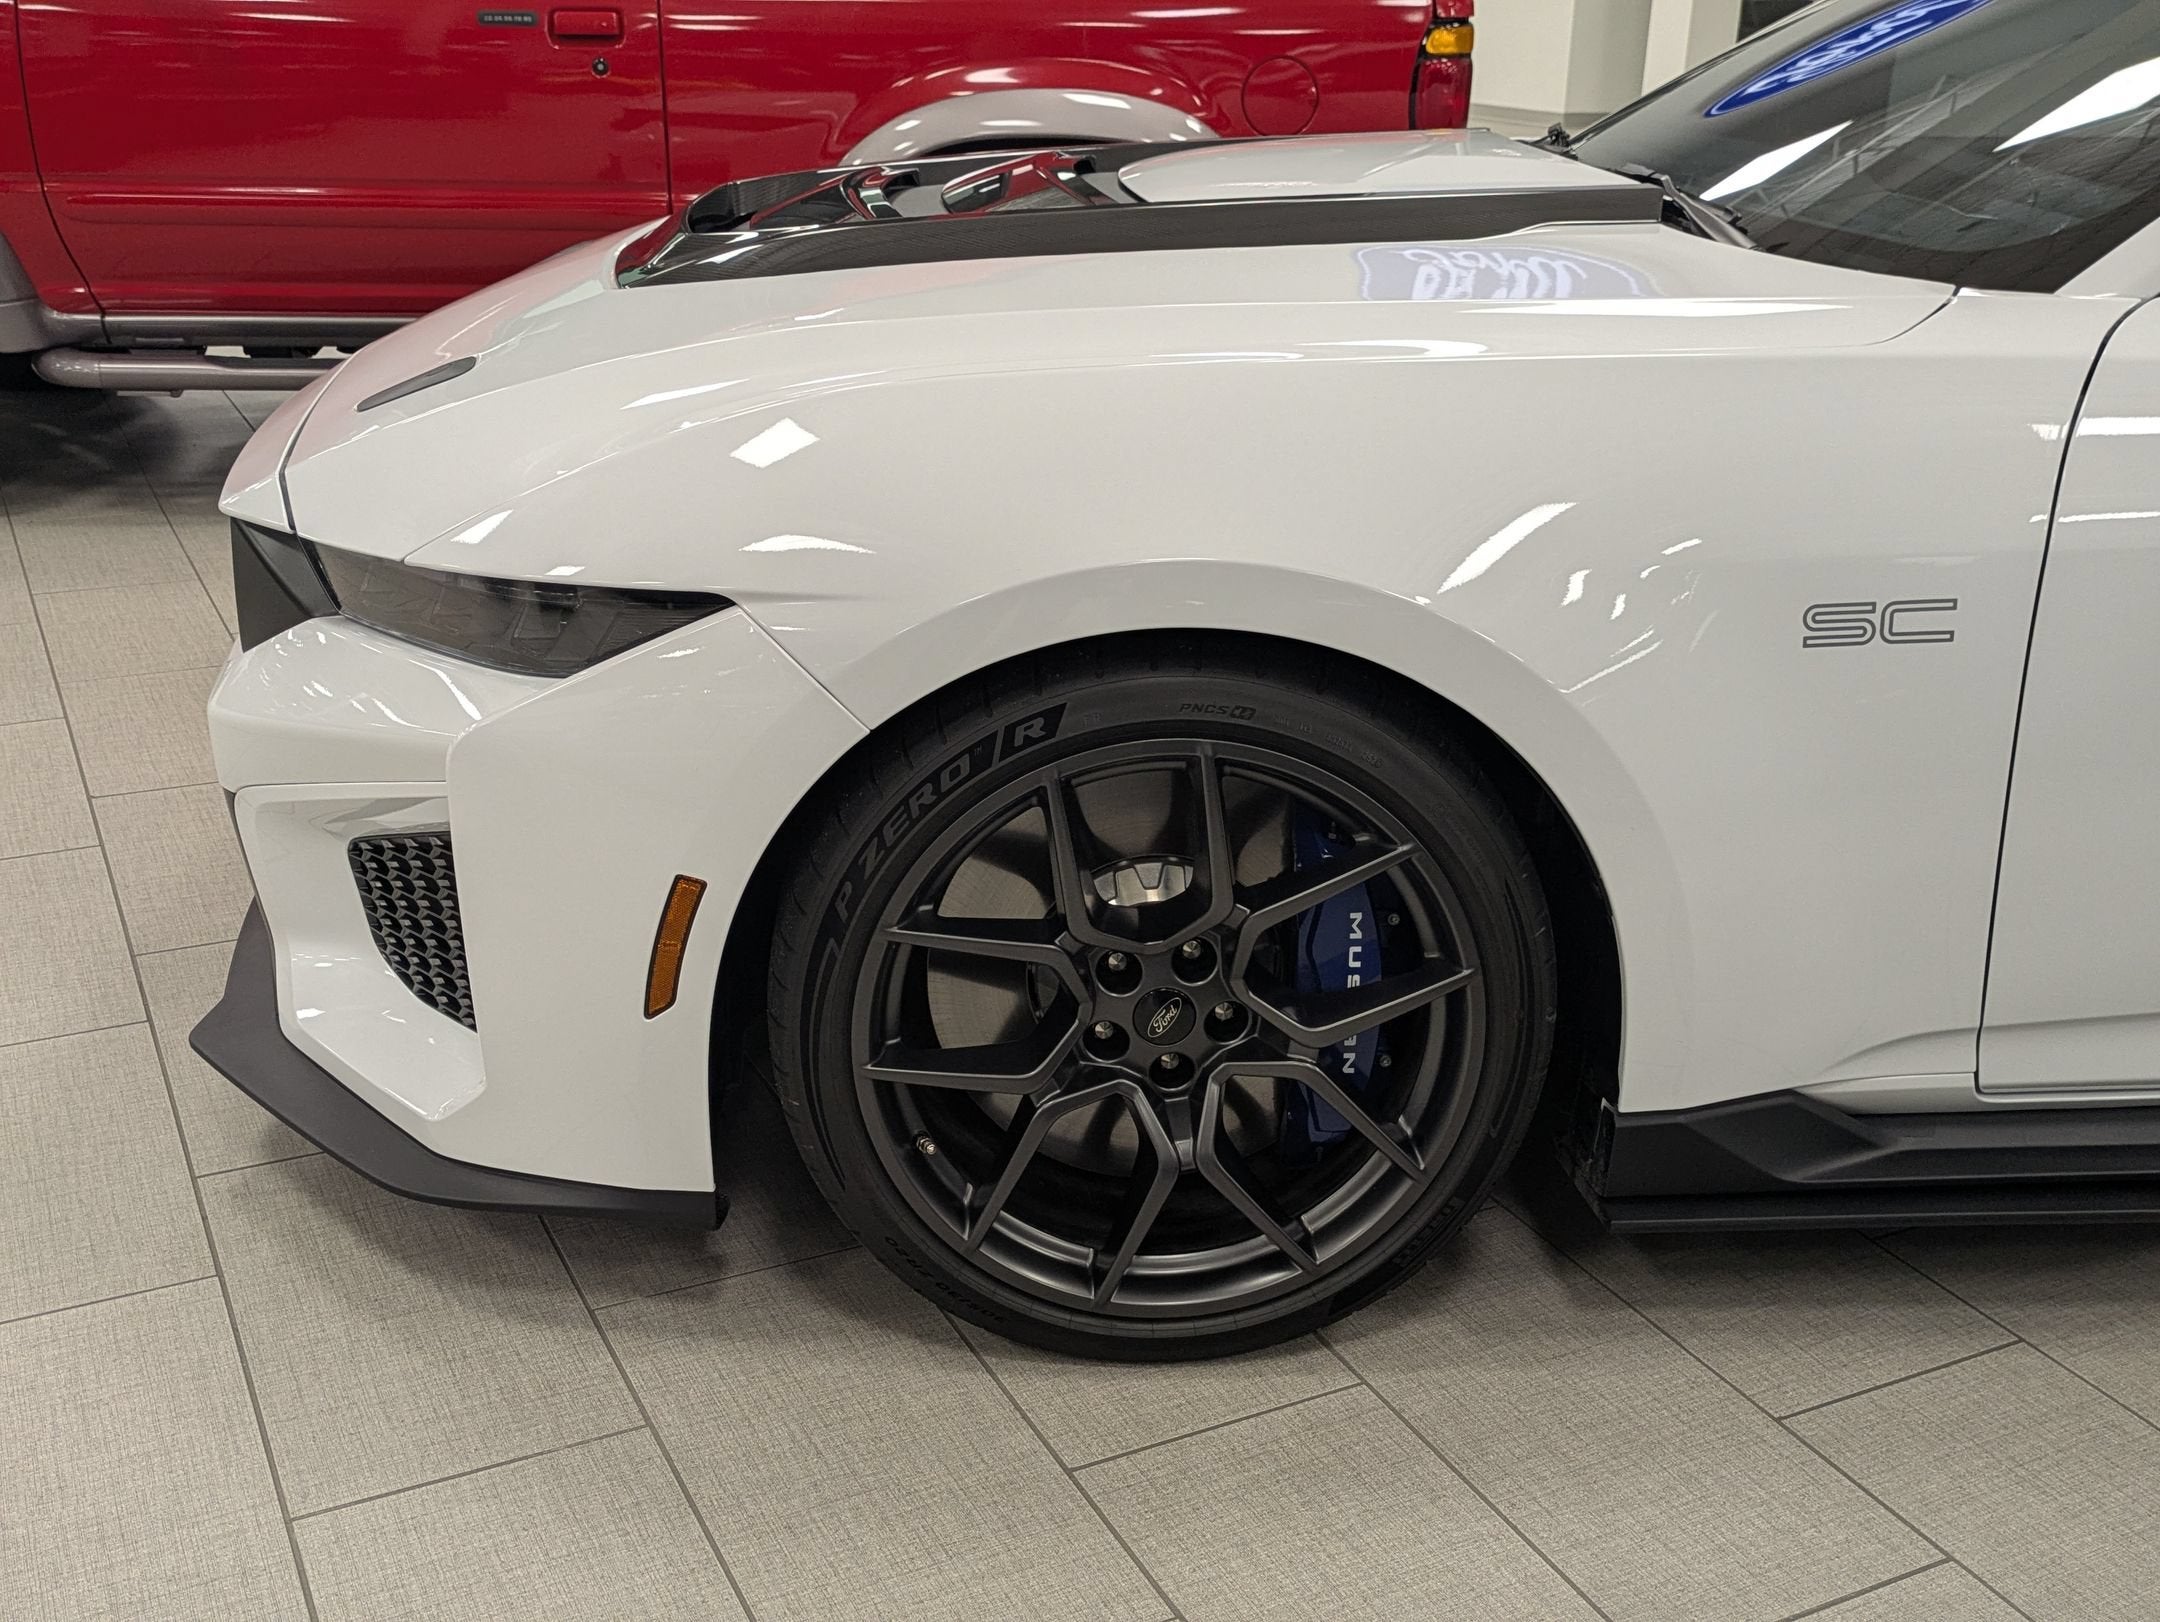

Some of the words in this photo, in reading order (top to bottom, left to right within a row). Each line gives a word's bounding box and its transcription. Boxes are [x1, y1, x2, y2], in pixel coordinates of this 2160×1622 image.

[1802, 598, 1958, 648] SC
[835, 881, 853, 923] P
[1013, 717, 1046, 747] R
[1153, 1004, 1178, 1033] Ford
